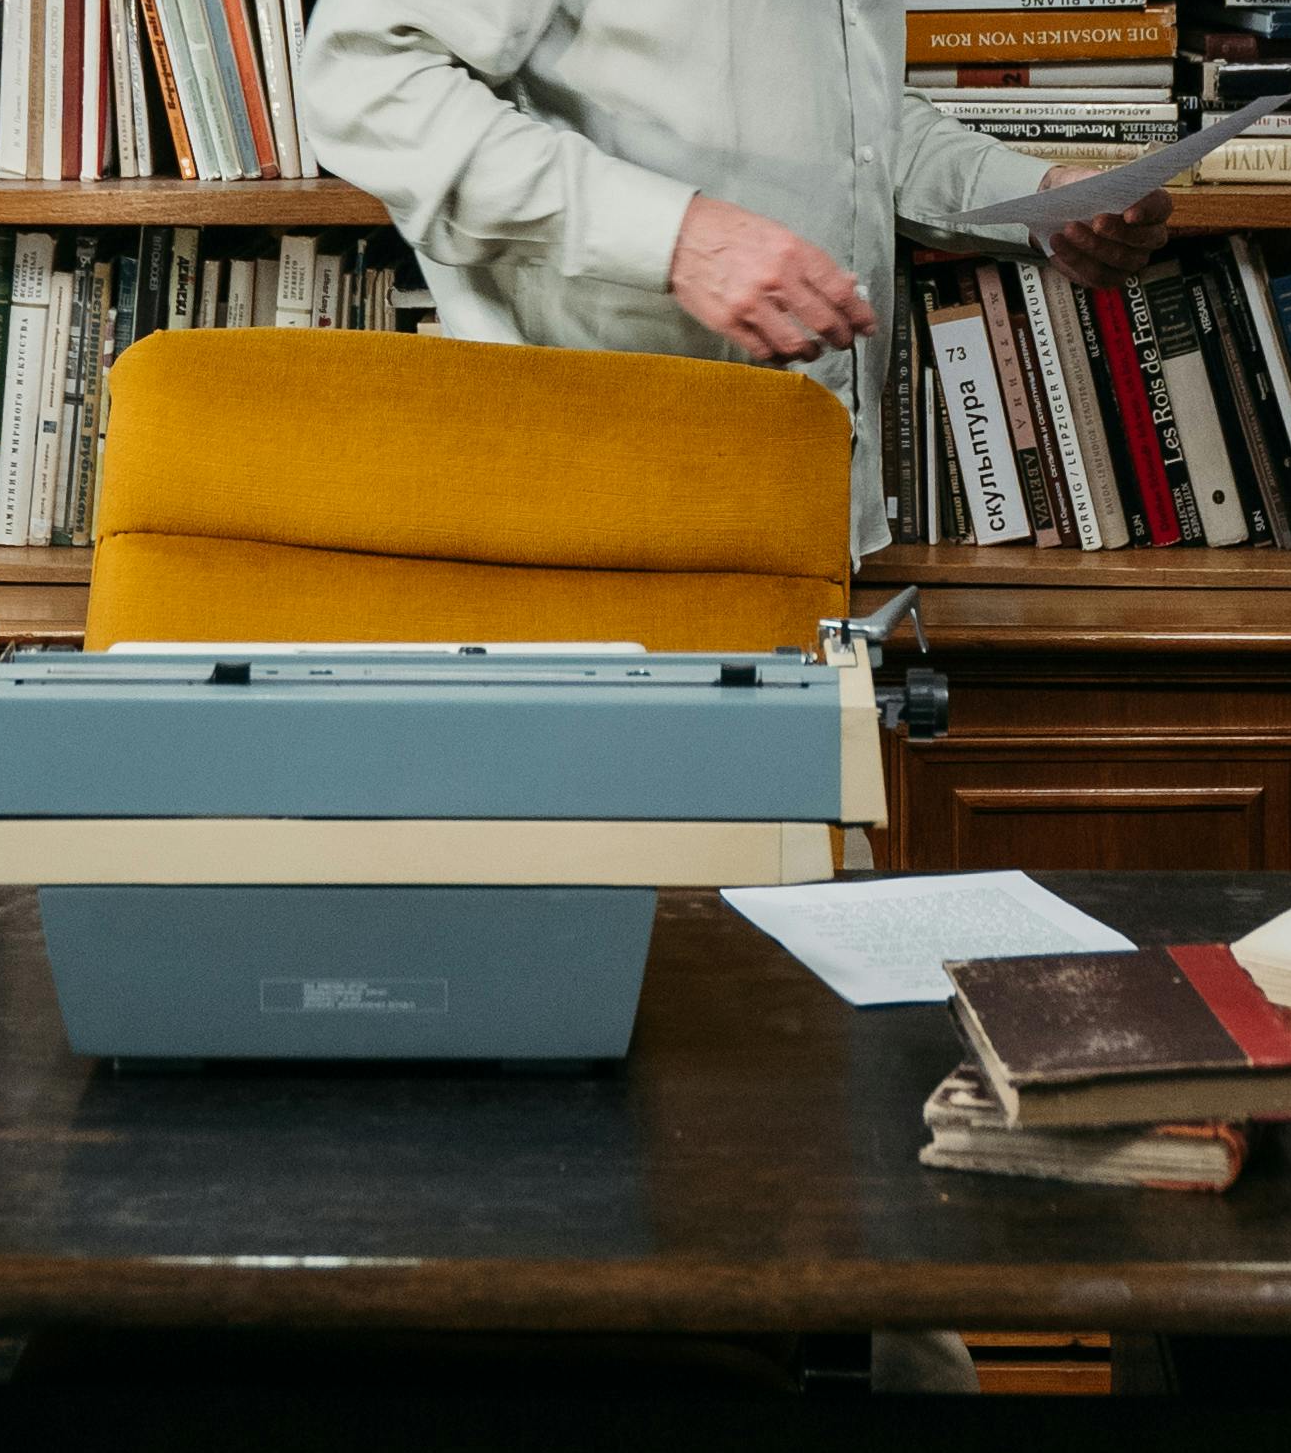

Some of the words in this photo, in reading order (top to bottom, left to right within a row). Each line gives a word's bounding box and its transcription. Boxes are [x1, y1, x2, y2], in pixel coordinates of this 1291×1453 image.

[930, 31, 970, 46] ROM
[978, 30, 1016, 45] VON
[1022, 28, 1121, 44] MOSAIKEN
[1126, 27, 1157, 42] DIE
[979, 123, 1040, 137] Châteaux
[1043, 123, 1114, 137] Merveilleux
[1021, 263, 1056, 375] PLAKATKUNST
[1120, 275, 1153, 344] France
[1191, 285, 1213, 334] VERSAILLES
[15, 316, 30, 384] ИСКУССТВА
[945, 347, 966, 363] 73
[1138, 347, 1161, 375] de
[1145, 376, 1173, 423] Rois
[10, 392, 24, 453] МИРОВОГО
[1048, 382, 1077, 465] LEIPZIGER
[958, 377, 1011, 533] скульптура
[1157, 426, 1184, 464] Les
[3, 460, 19, 535] ПАМЯТНИКИ
[1071, 481, 1095, 545] HORNIG
[1132, 513, 1146, 535] SUN
[1252, 509, 1266, 531] SUN
